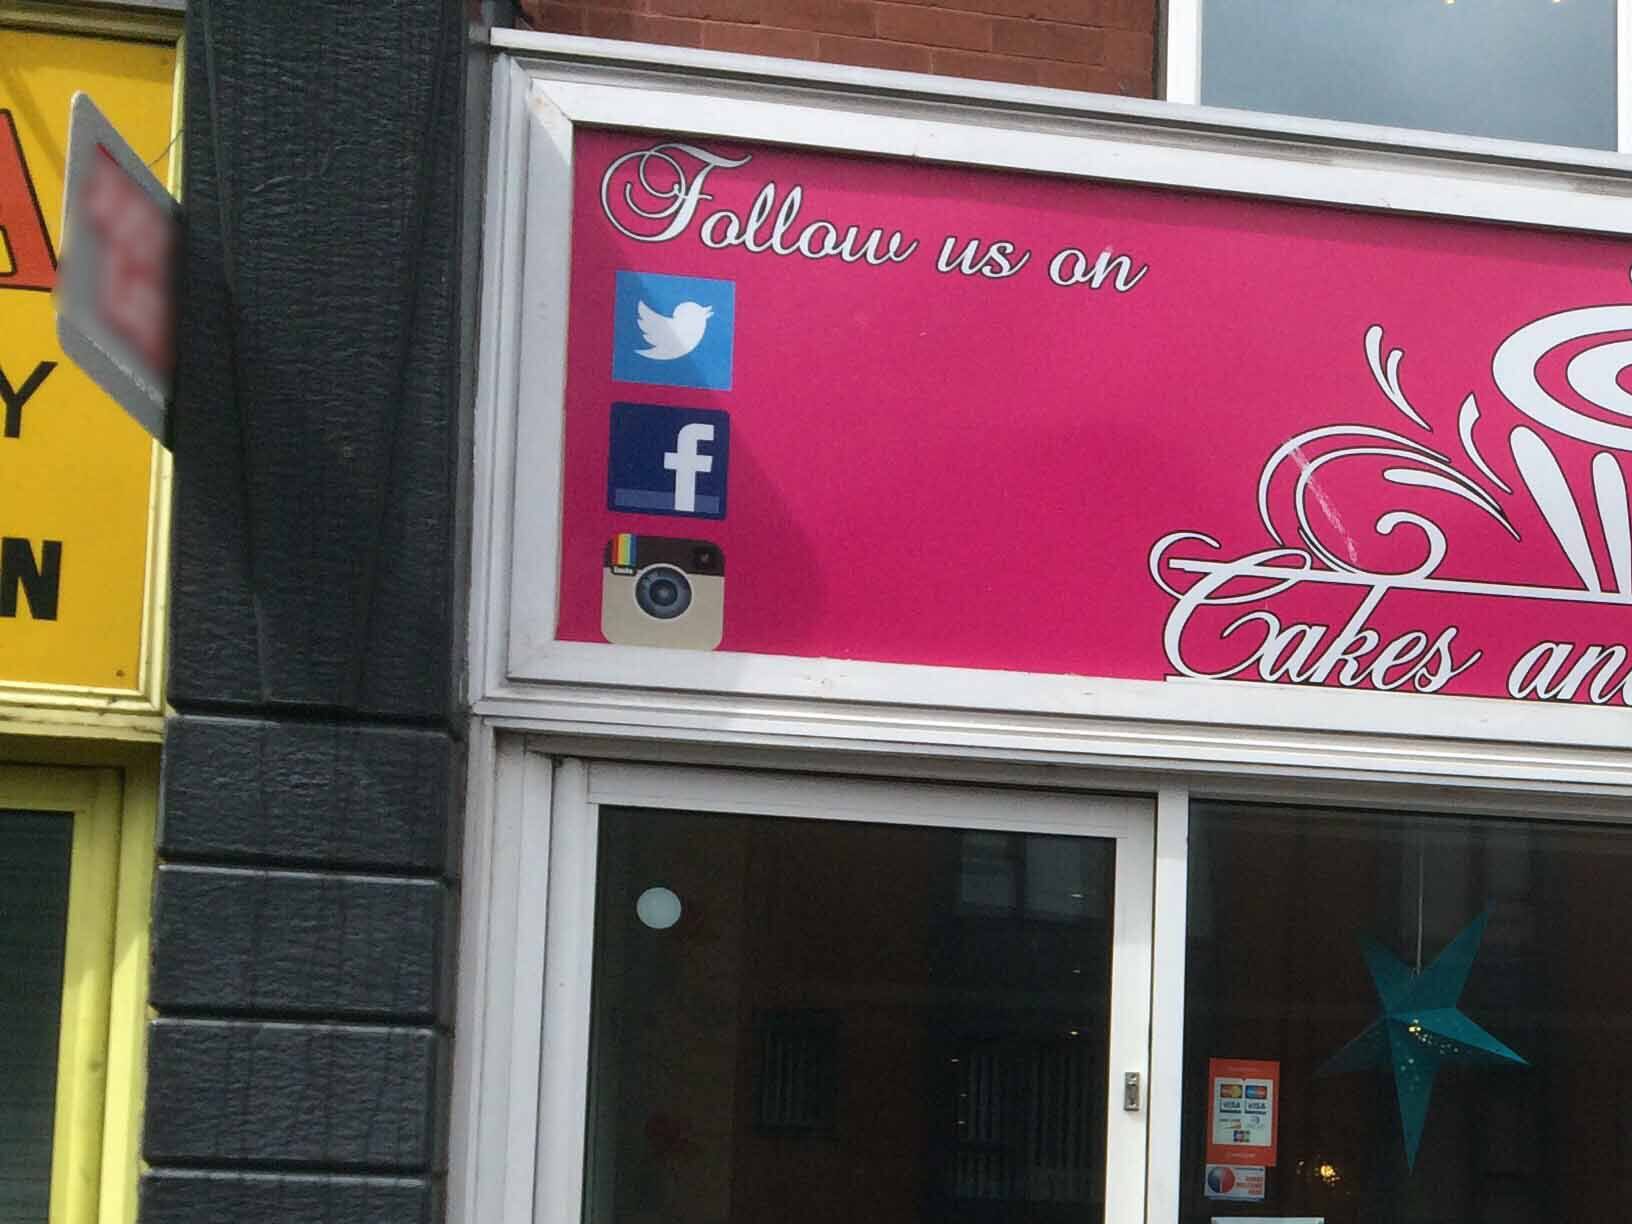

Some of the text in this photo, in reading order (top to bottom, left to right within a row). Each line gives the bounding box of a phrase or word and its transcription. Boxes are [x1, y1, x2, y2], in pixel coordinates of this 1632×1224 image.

[601, 142, 1148, 293] Follow us on
[1148, 530, 1482, 693] Cakes
